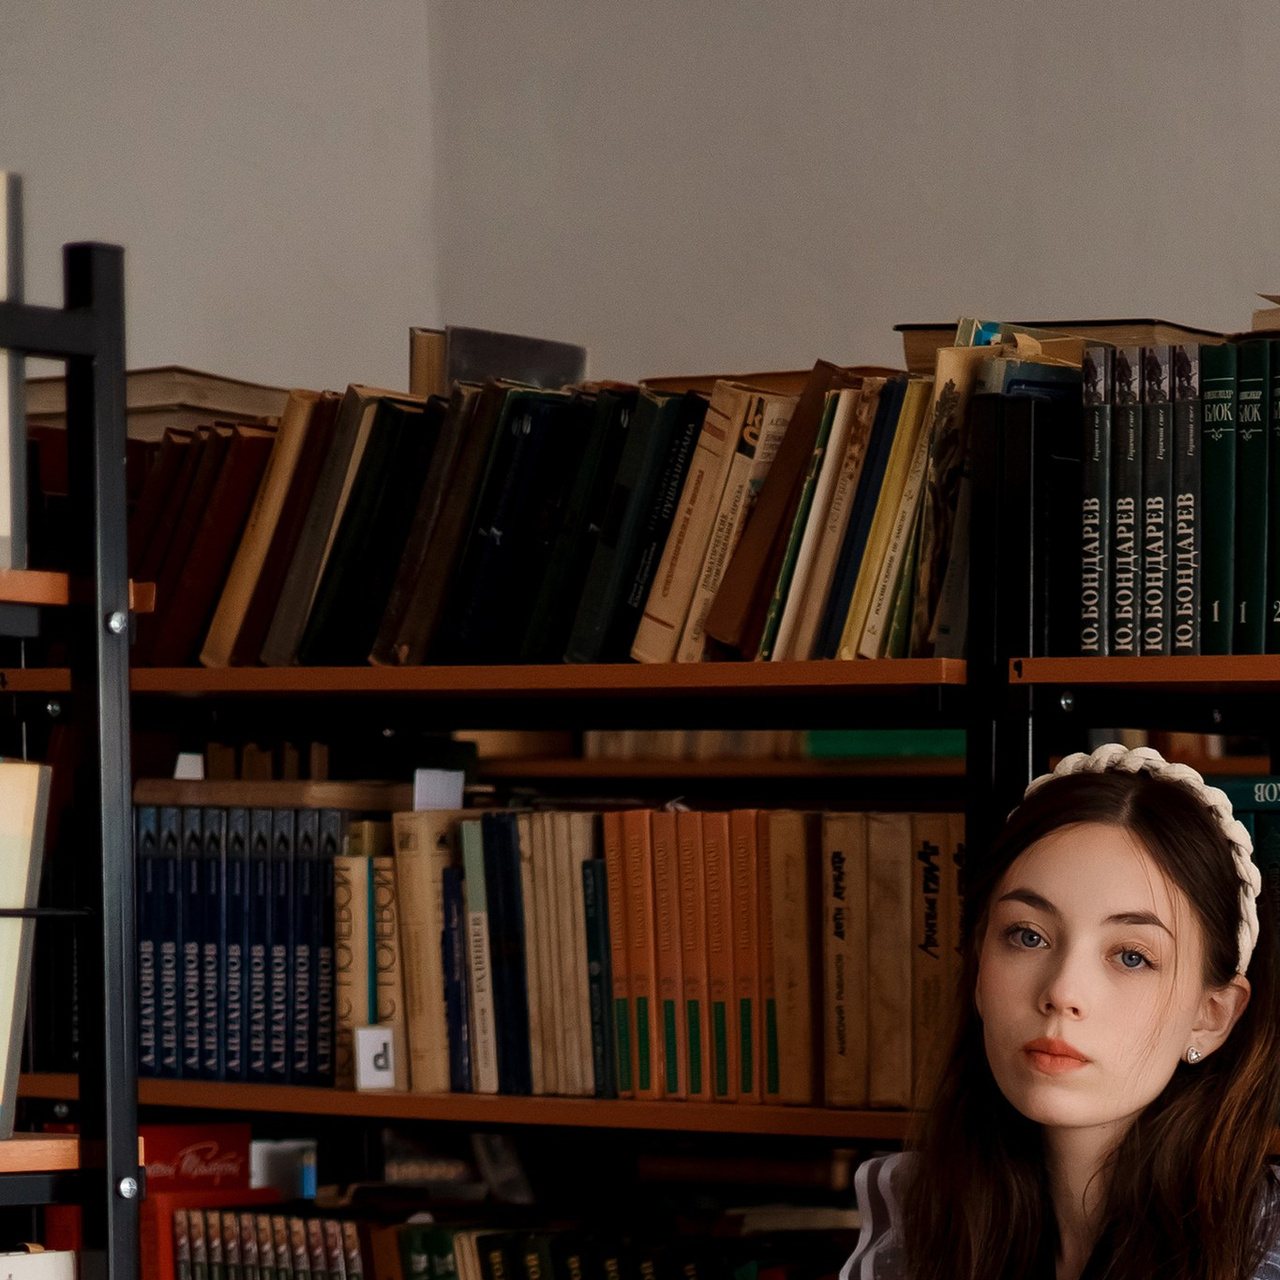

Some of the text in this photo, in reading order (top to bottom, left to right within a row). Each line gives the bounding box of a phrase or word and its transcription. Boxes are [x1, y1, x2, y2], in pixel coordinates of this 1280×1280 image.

[1204, 402, 1233, 422] БЛОК
[1082, 497, 1104, 651] Ю. БОНДАРЕВ
[1115, 497, 1139, 651] Ю. БОНДАРЕВ
[1145, 496, 1168, 651] Ю. БОНДАРЕВ
[1175, 493, 1198, 648] Ю. БОНДАРЕВ
[1212, 600, 1220, 622] 1
[1239, 600, 1246, 623] 1
[374, 1043, 388, 1070] Р
